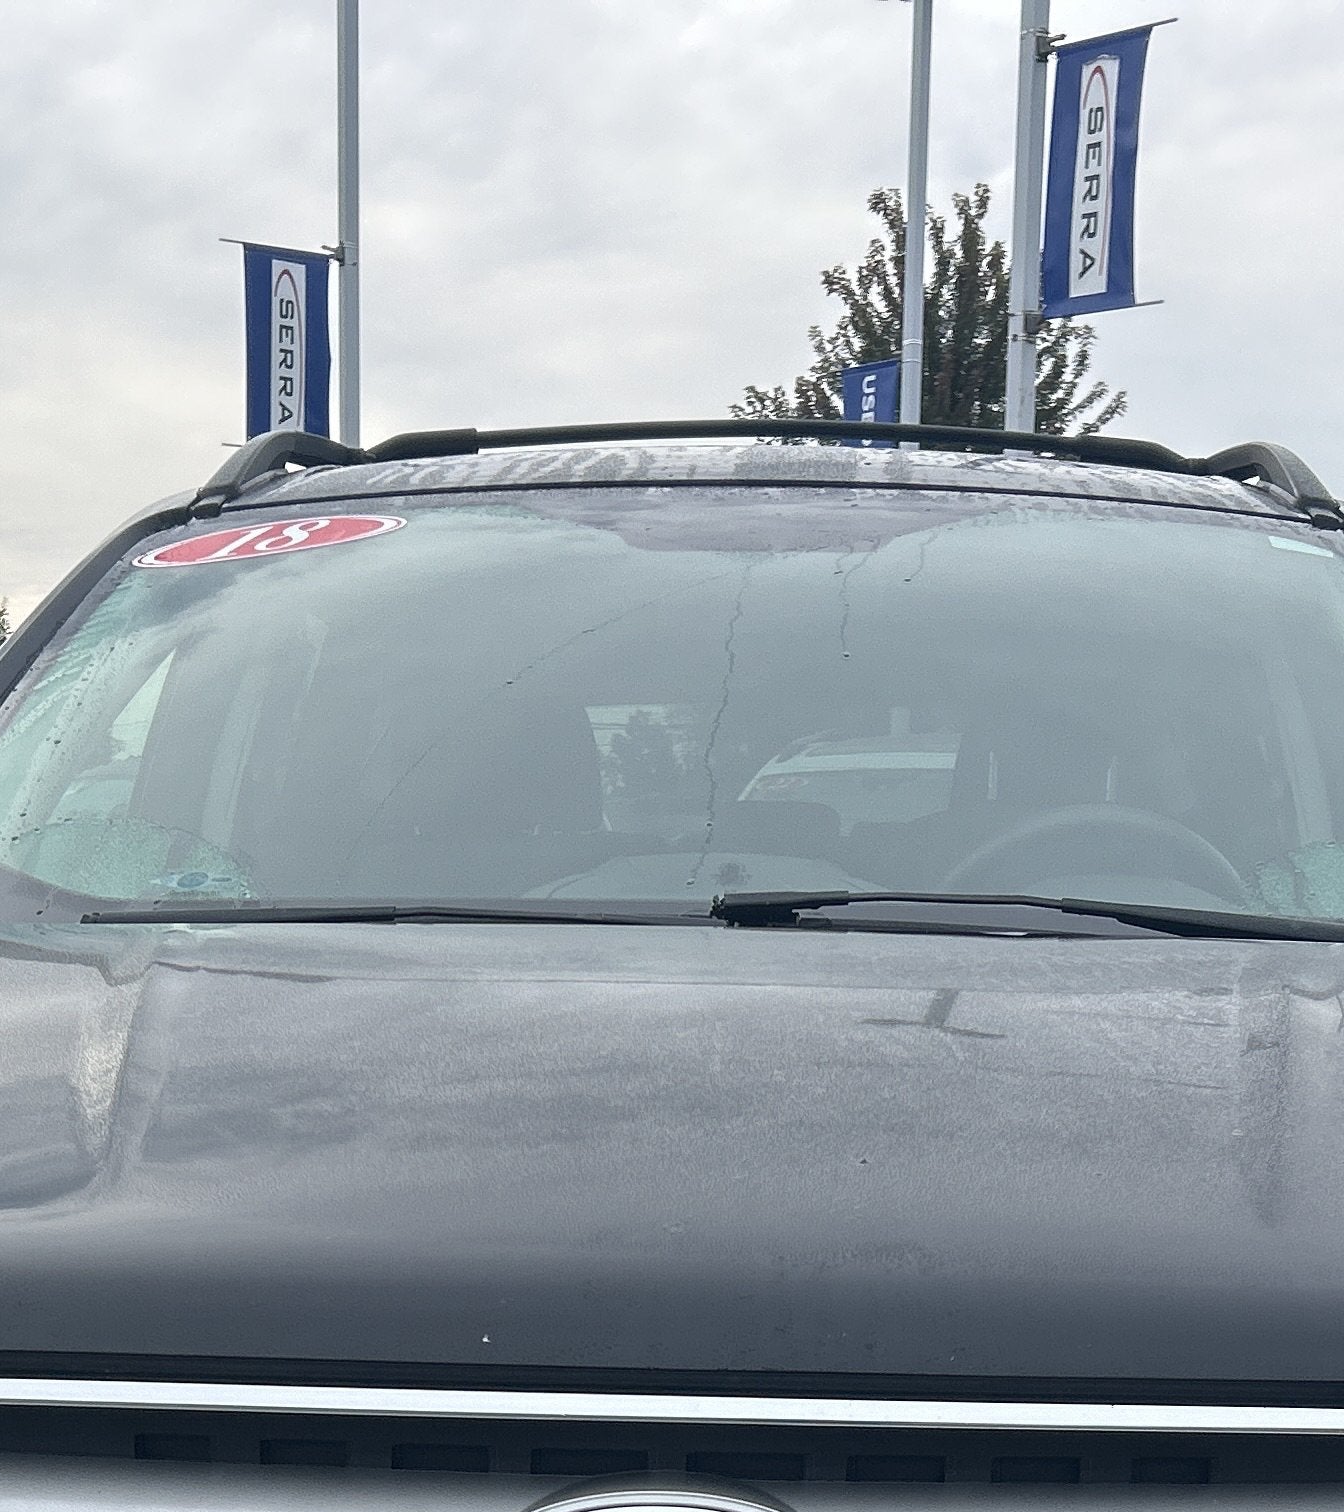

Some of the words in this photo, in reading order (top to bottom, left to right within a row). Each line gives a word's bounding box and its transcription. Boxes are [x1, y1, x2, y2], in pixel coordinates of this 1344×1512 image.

[1078, 106, 1104, 280] SERRA
[278, 298, 295, 425] SERRA
[195, 519, 332, 561] 18
